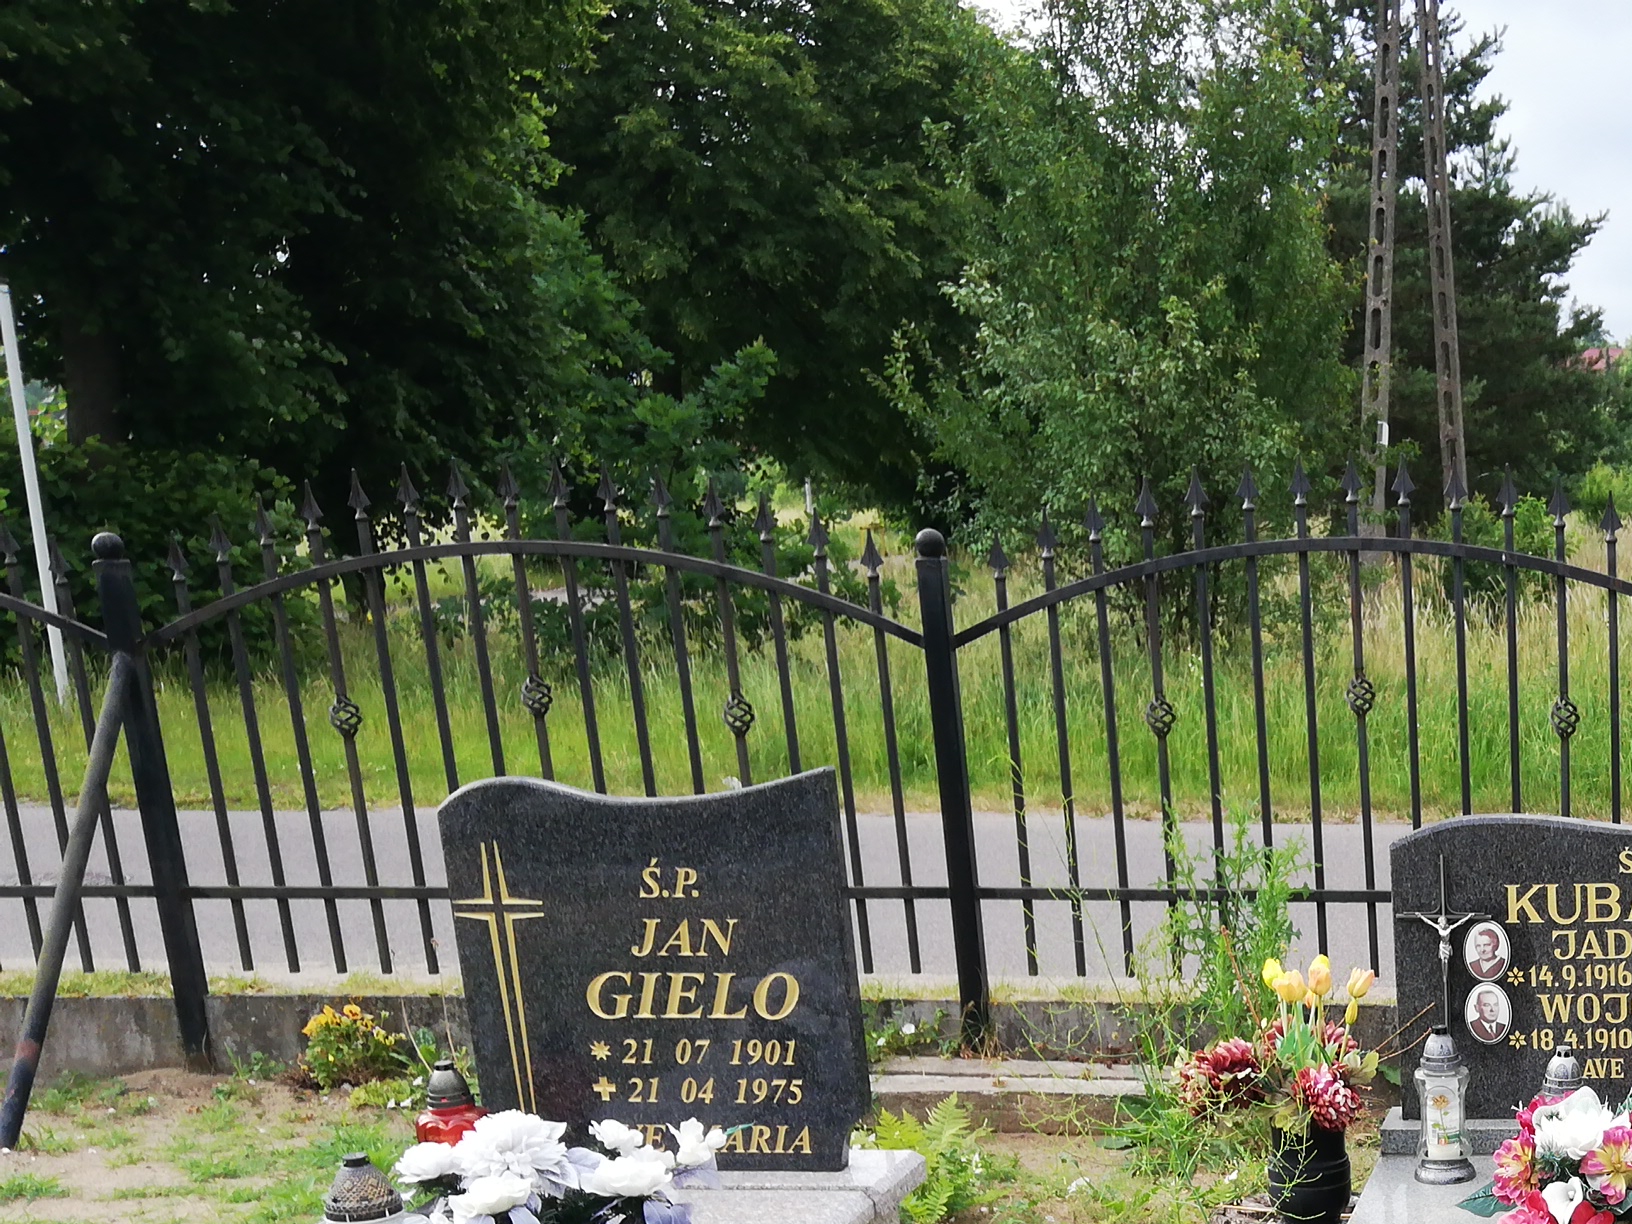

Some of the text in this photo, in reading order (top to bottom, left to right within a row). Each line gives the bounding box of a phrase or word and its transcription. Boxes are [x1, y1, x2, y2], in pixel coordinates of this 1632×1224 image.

[640, 857, 699, 898] Ś.P.
[631, 918, 739, 957] JAN
[1529, 961, 1632, 990] 14.9.1916
[586, 971, 800, 1020] GIELO
[622, 1038, 797, 1066] 21 07 1901
[1582, 1058, 1625, 1079] AVE
[628, 1077, 804, 1105] 21 04 1975
[711, 1124, 812, 1154] ARIA
